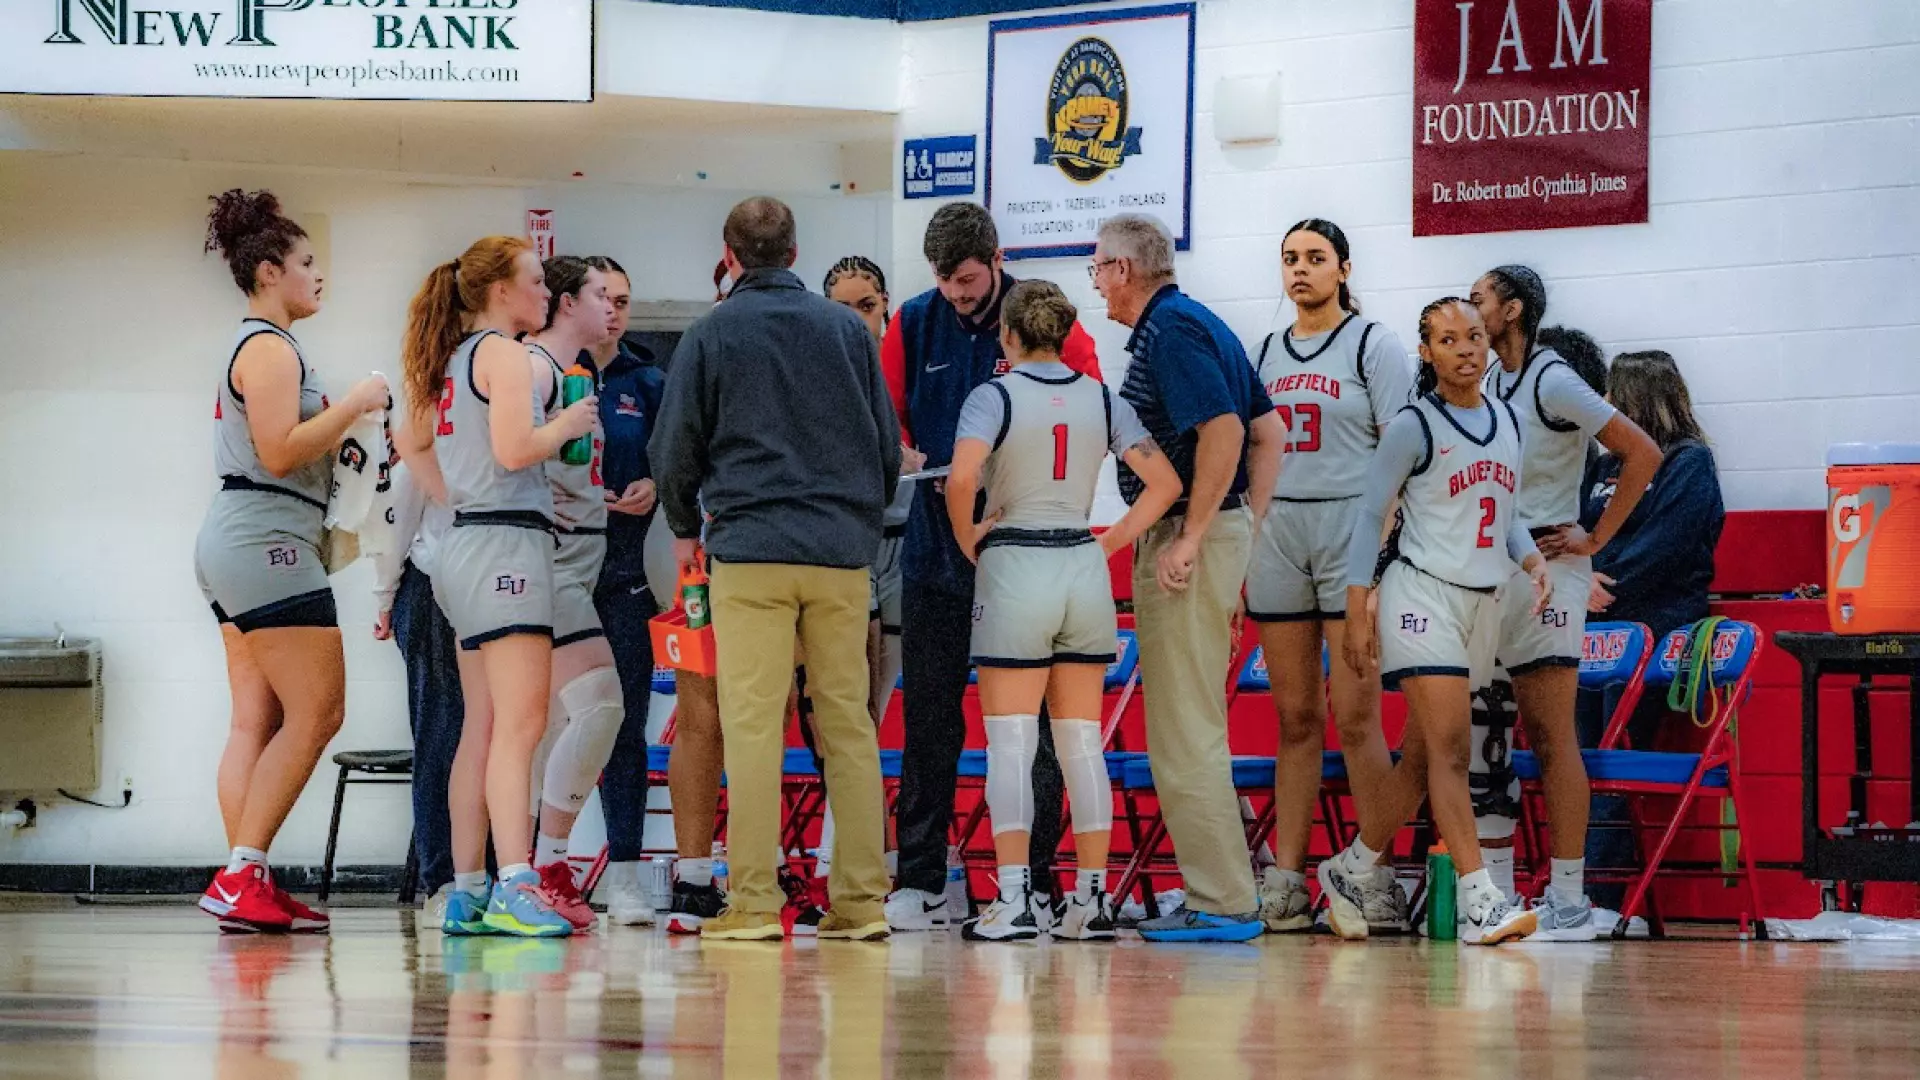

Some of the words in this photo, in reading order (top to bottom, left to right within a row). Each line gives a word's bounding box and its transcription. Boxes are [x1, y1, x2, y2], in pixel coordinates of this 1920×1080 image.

[372, 14, 520, 50] BANK
[193, 60, 519, 87] www.newpeoplesbank.com
[1422, 89, 1640, 144] FOUNDATION
[1432, 181, 1452, 203] Dr.
[1456, 179, 1500, 202] Robert
[1504, 176, 1530, 199] and
[1533, 172, 1586, 202] Cynthia
[1588, 171, 1627, 197] Jones
[531, 219, 552, 231] FIRE
[1052, 423, 1069, 481] 1
[1476, 496, 1496, 549] 2
[1832, 494, 1862, 543] G
[1581, 633, 1628, 660] AMS
